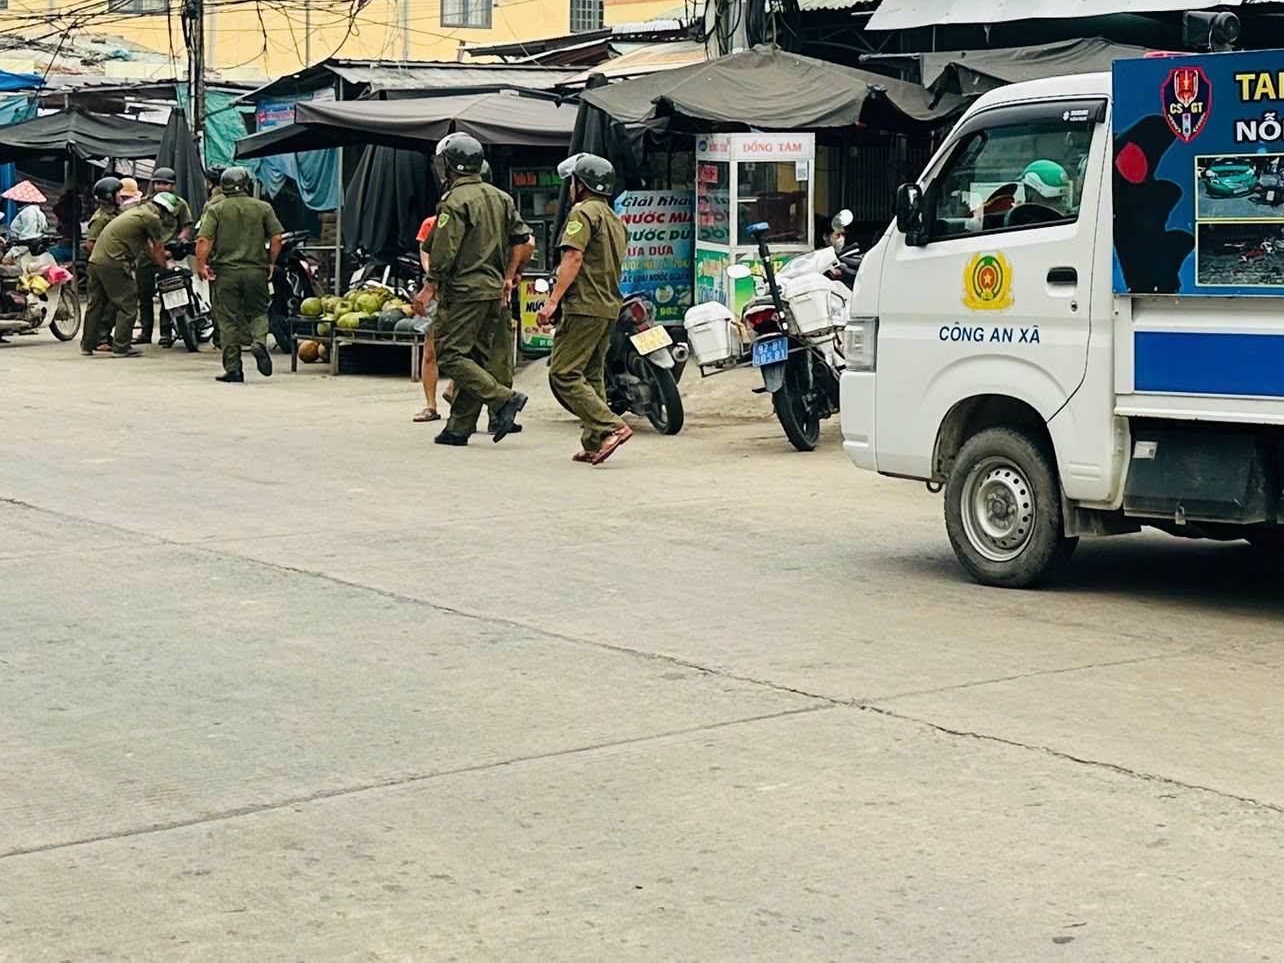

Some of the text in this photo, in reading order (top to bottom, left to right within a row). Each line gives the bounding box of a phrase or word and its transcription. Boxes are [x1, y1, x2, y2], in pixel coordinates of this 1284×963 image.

[1169, 101, 1204, 115] CS GT
[938, 321, 1041, 345] CÔNG AN XÃ
